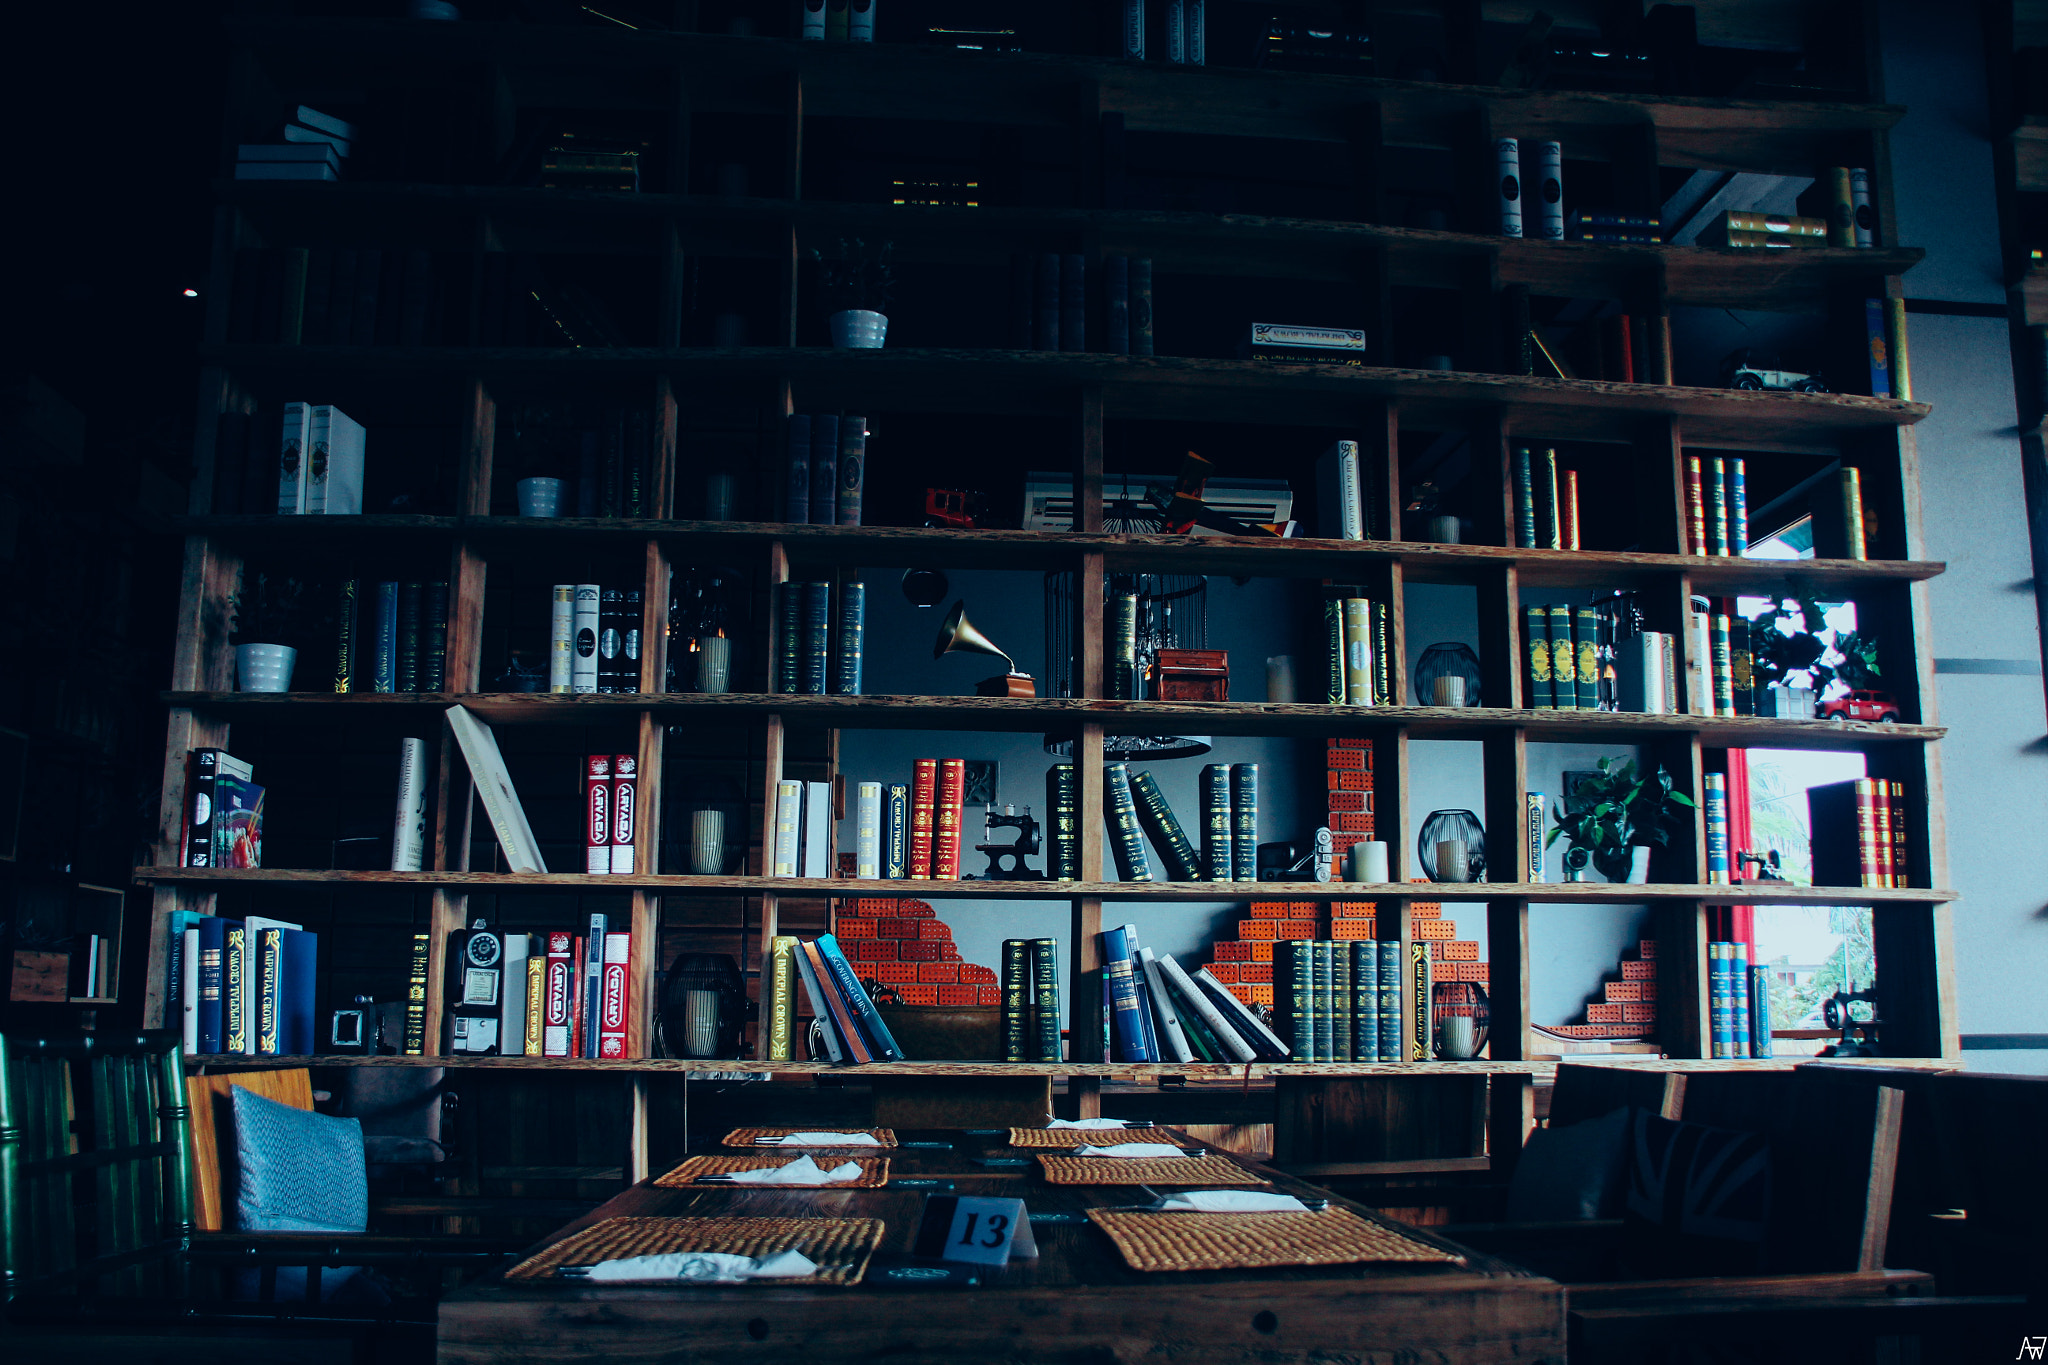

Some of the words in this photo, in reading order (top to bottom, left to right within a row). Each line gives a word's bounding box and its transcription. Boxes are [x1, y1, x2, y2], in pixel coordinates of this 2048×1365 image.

[594, 788, 604, 841] ARVADA
[618, 786, 629, 840] ARVADA
[229, 950, 240, 984] CROWN
[552, 965, 563, 1022] ARVADA
[609, 969, 620, 1024] ARVADA
[853, 993, 872, 1018] CHINA
[261, 997, 273, 1032] CROWN
[530, 1011, 539, 1039] CROWN
[775, 1005, 786, 1039] CROWN
[958, 1212, 1009, 1248] 13
